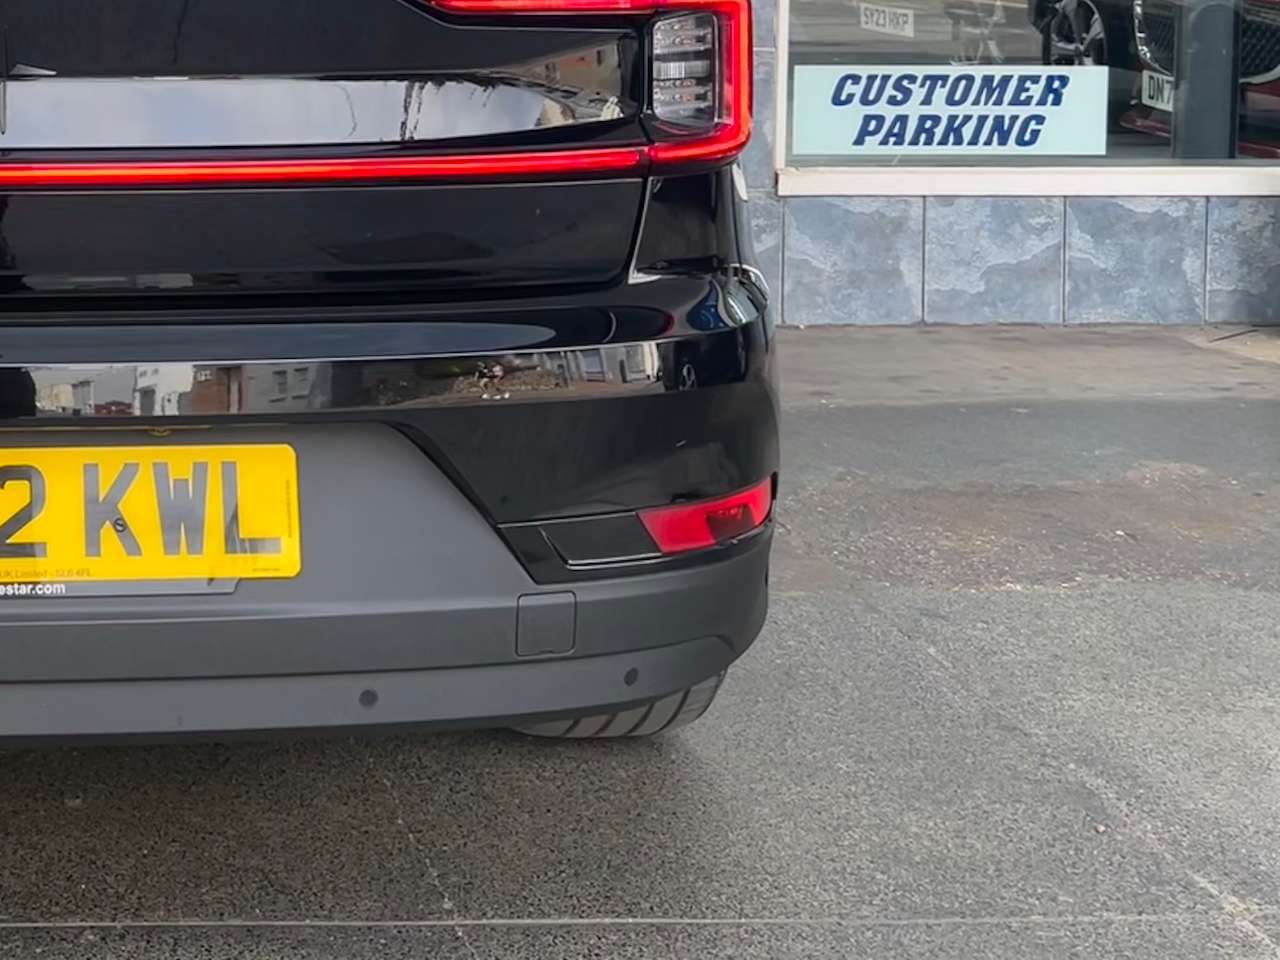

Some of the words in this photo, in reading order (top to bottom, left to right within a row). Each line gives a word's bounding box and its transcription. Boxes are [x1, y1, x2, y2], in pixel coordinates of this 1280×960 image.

[831, 73, 1071, 107] CUSTOMER
[852, 114, 1046, 147] PARKING
[82, 460, 282, 558] KWL
